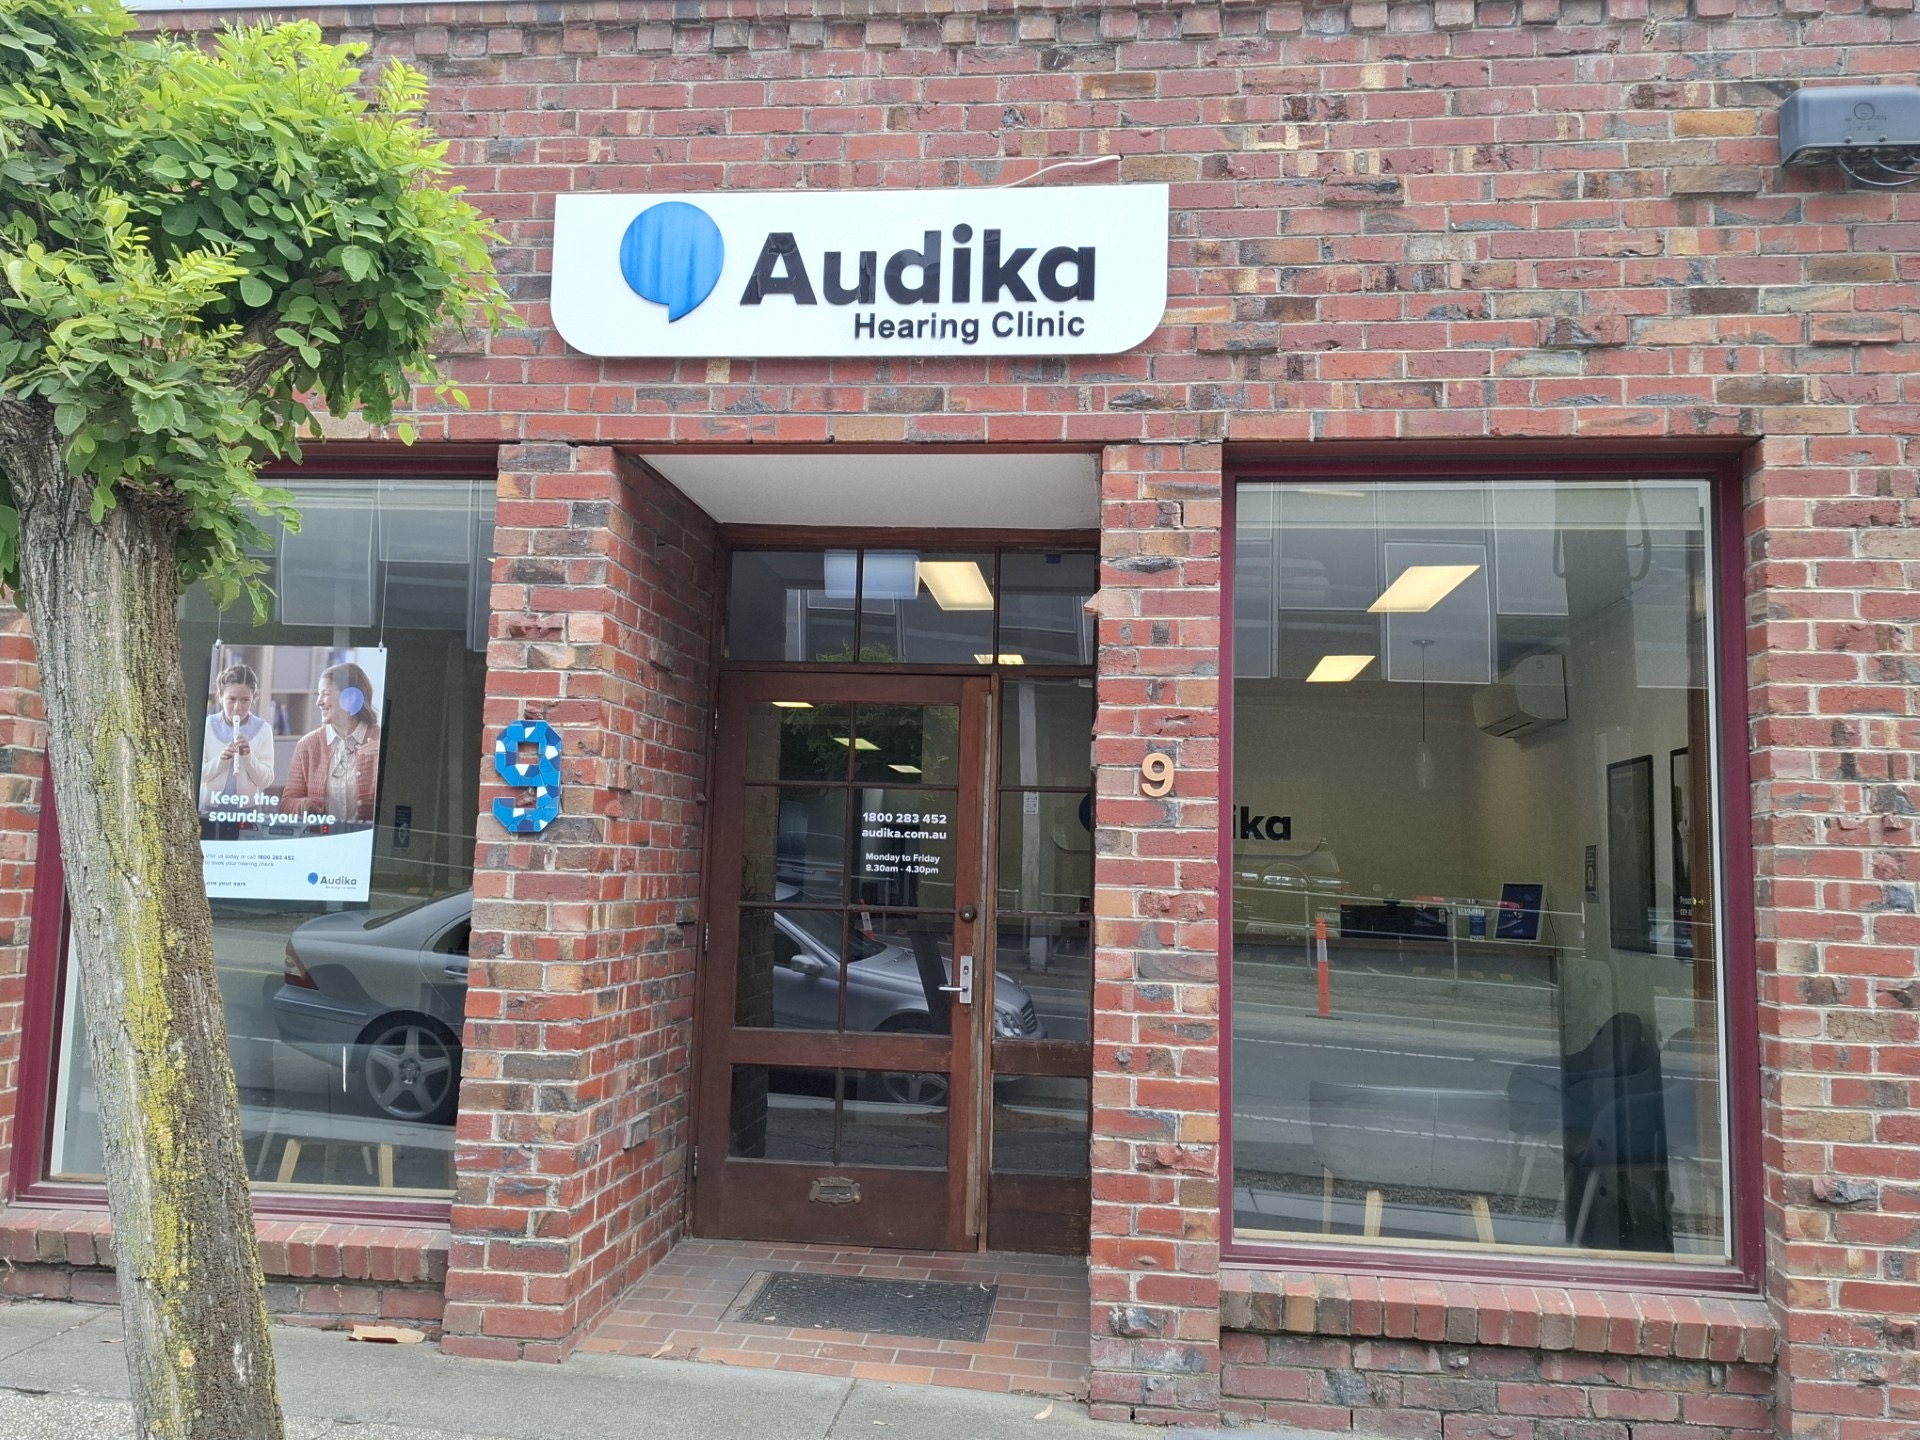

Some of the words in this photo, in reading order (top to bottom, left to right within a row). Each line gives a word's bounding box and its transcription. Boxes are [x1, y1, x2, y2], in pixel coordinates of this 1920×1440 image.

[739, 222, 1096, 306] Audika
[853, 312, 980, 344] Hearing
[991, 310, 1086, 339] Clinic
[492, 719, 562, 833] 9
[1141, 752, 1175, 797] 9
[210, 791, 249, 807] Keep
[253, 792, 280, 806] the
[208, 809, 265, 823] sounds
[269, 812, 298, 826] you
[302, 811, 336, 825] love
[863, 812, 893, 822] 1800
[896, 813, 919, 823] 283
[922, 814, 947, 824] 452
[861, 827, 947, 840] audika.com.au
[865, 852, 900, 863] Monday
[902, 854, 911, 862] to
[913, 854, 940, 864] Friday
[865, 864, 899, 873] 8.30am
[905, 865, 939, 875] 4.30pm
[320, 875, 357, 885] Audika
